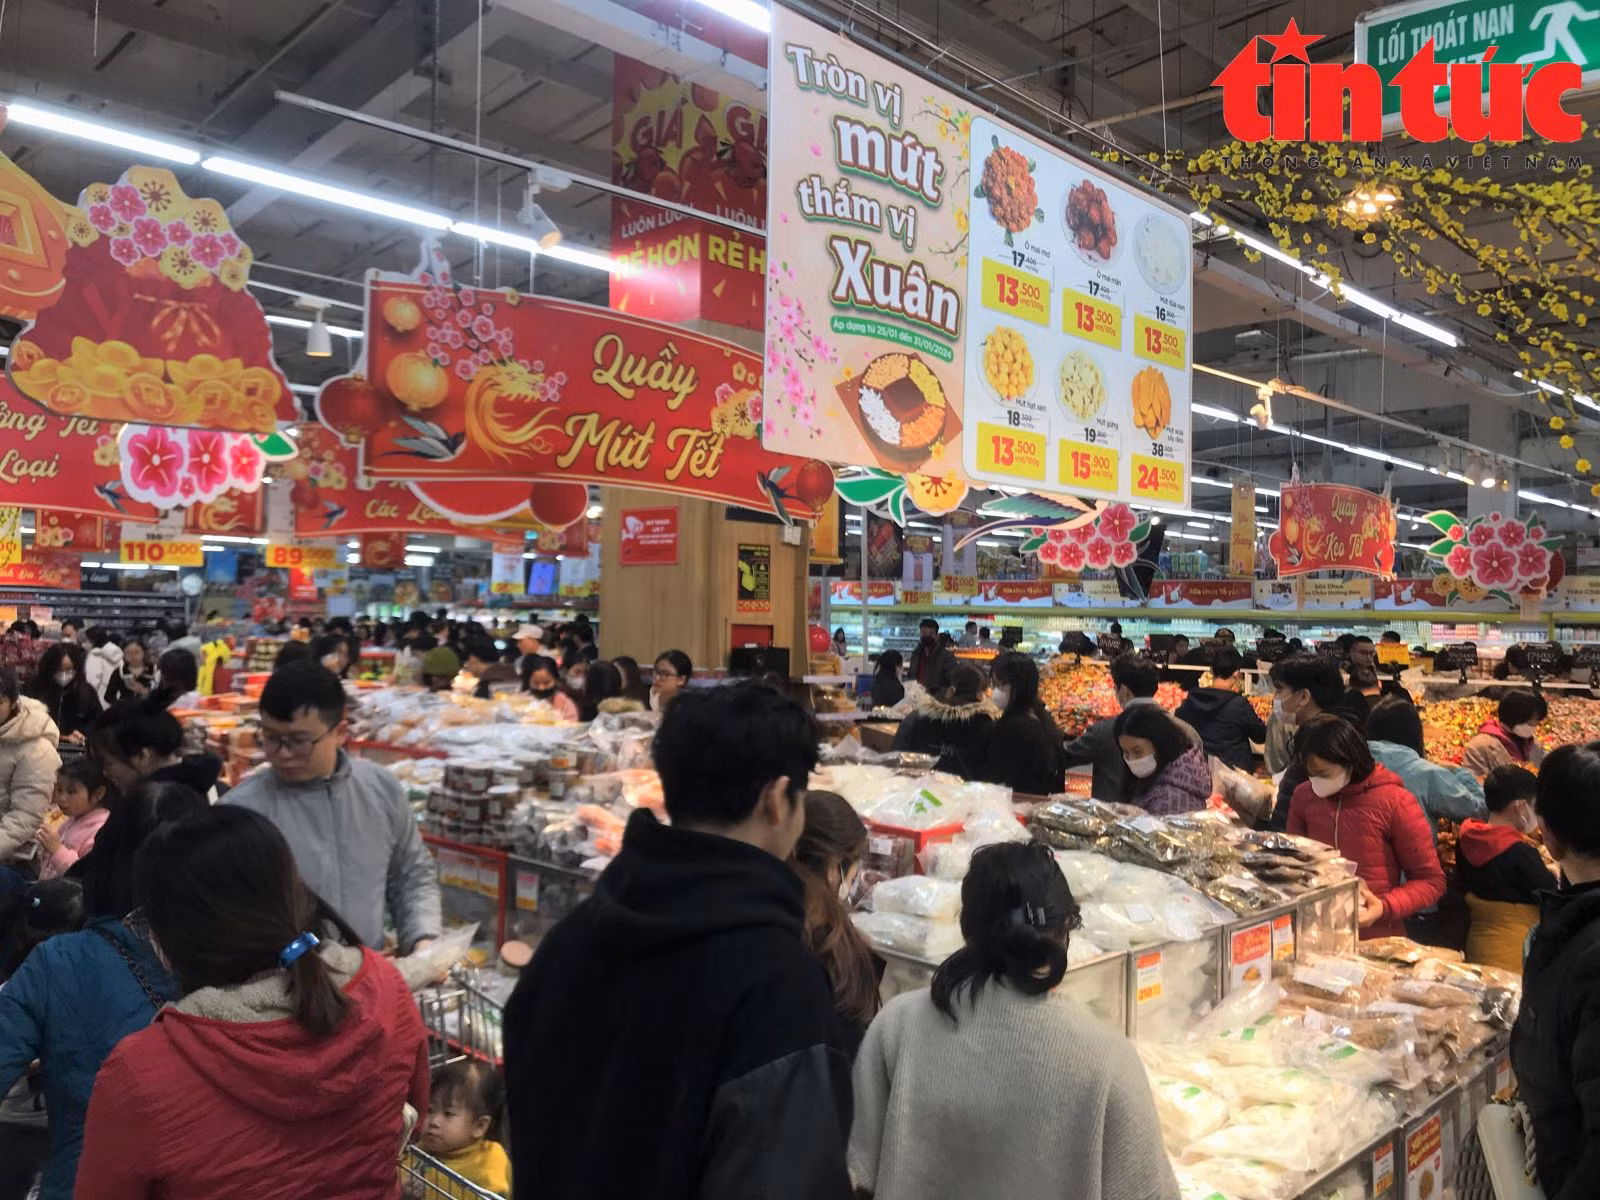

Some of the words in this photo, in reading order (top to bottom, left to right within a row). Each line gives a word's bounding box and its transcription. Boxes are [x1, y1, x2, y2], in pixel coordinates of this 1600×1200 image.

[1379, 22, 1405, 66] LỐI
[1473, 3, 1514, 45] NẠN
[785, 43, 868, 106] Tròn
[873, 80, 902, 129] vị
[631, 97, 688, 150] GIÁ
[724, 103, 767, 150] GI
[833, 115, 944, 204] mứt
[798, 174, 881, 230] thắm
[888, 205, 916, 250] vị
[647, 232, 700, 271] HƠN
[708, 231, 745, 270] RẺ
[829, 235, 960, 338] Xuân
[877, 326, 898, 338] 25/01
[592, 334, 699, 410] Quầy
[556, 411, 656, 473] Mứt
[664, 425, 726, 481] Tết
